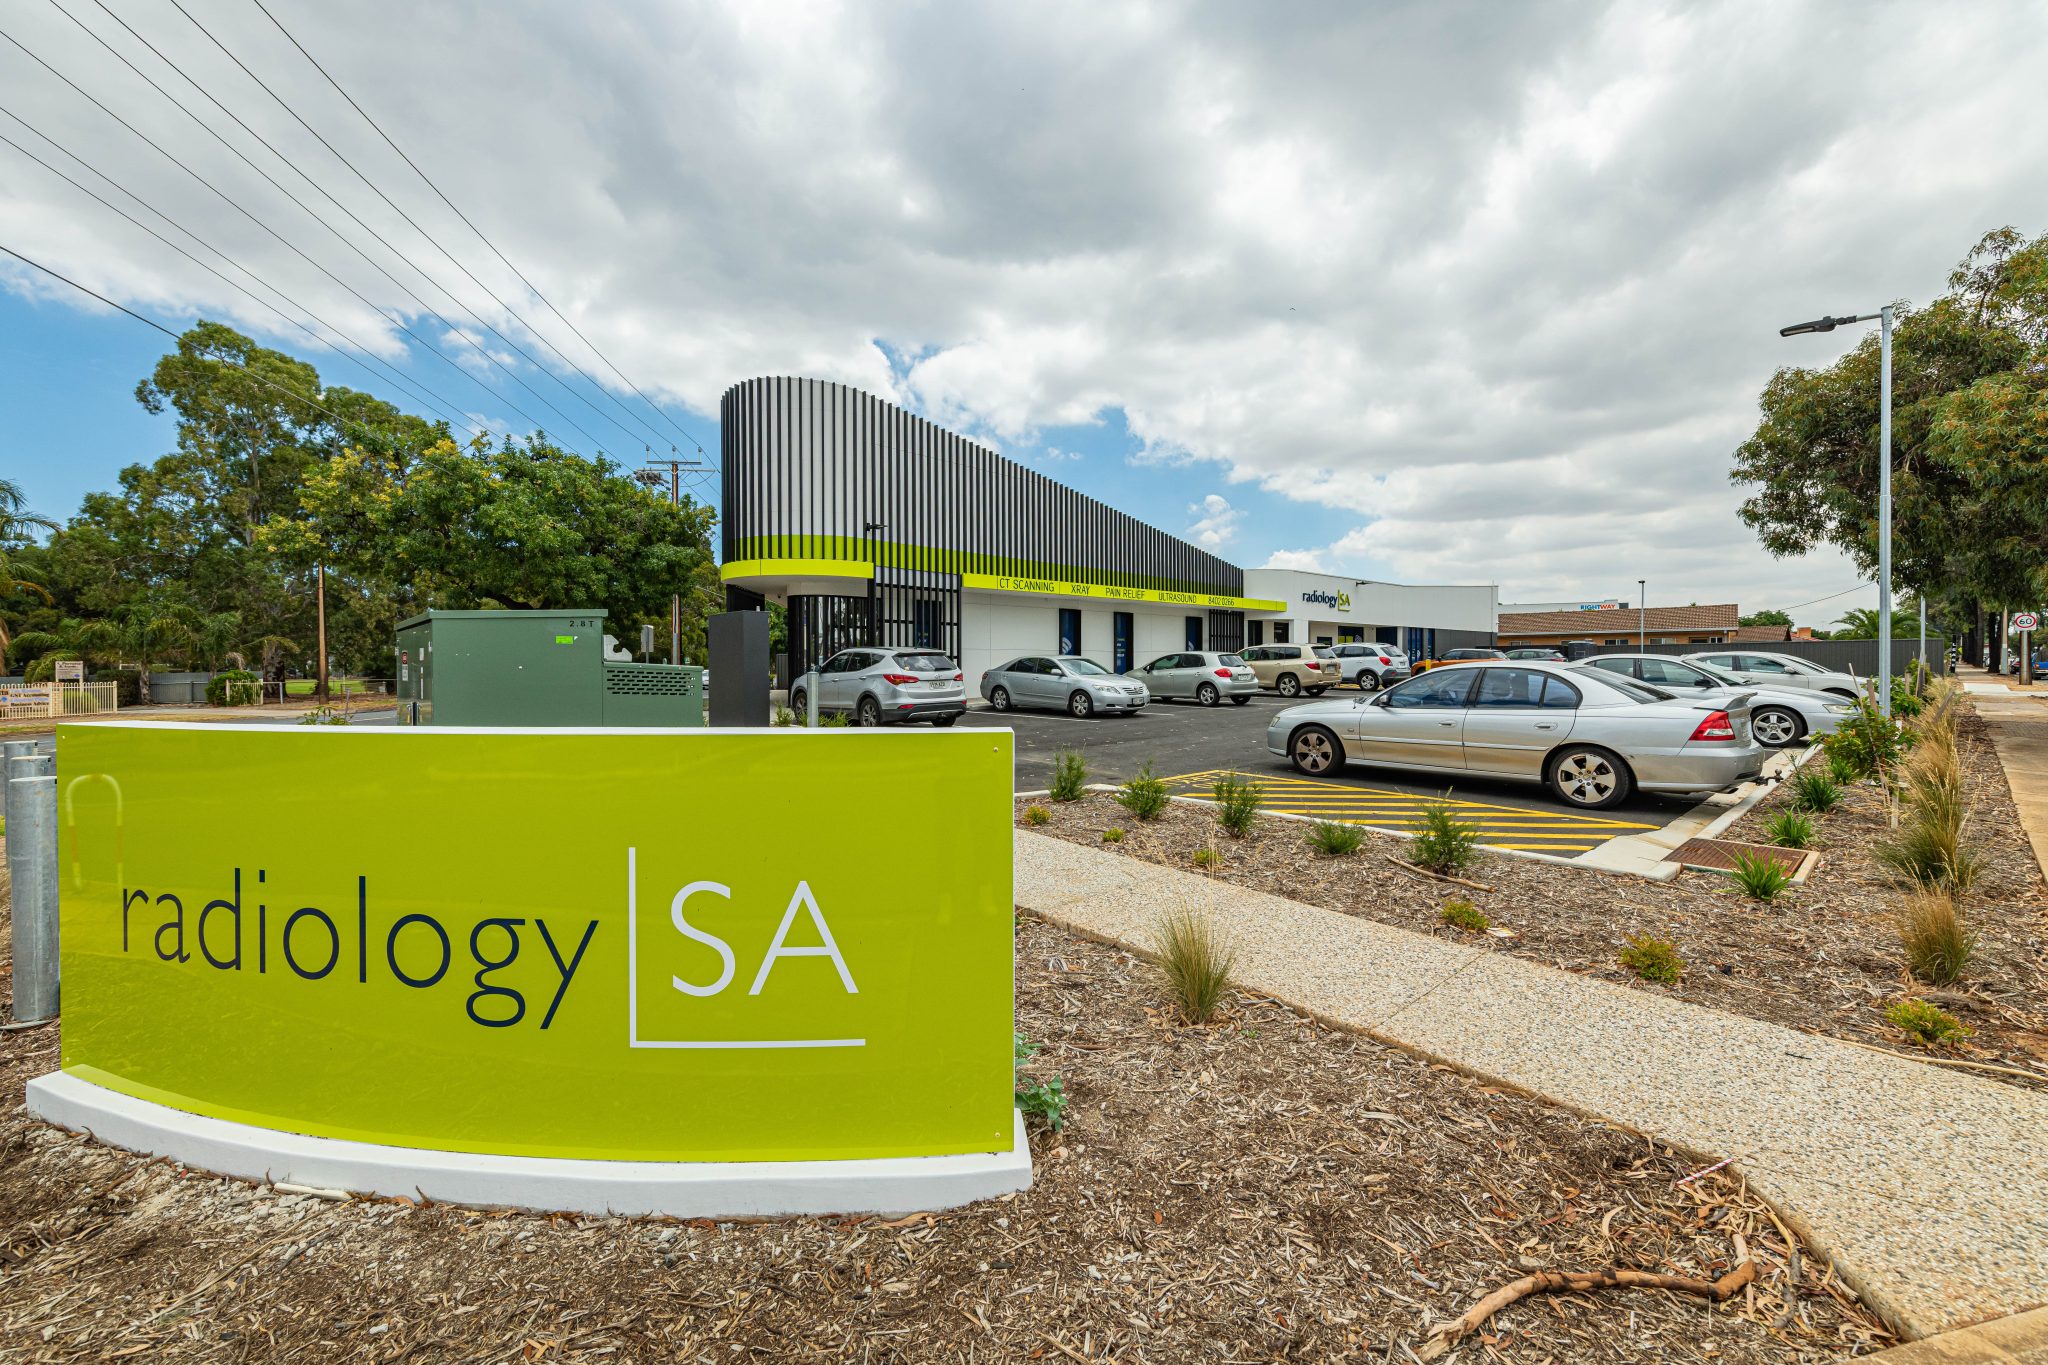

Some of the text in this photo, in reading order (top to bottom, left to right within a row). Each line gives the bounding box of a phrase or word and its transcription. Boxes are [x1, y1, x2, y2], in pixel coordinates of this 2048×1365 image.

[999, 577, 1055, 592] CT SCANNING
[1071, 584, 1090, 595] XRAY
[1105, 587, 1145, 600] PAIN RELIEF
[1158, 591, 1197, 604] ULTRASOUND
[1302, 589, 1351, 609] radiology SA
[121, 867, 860, 1030] radiology SA
